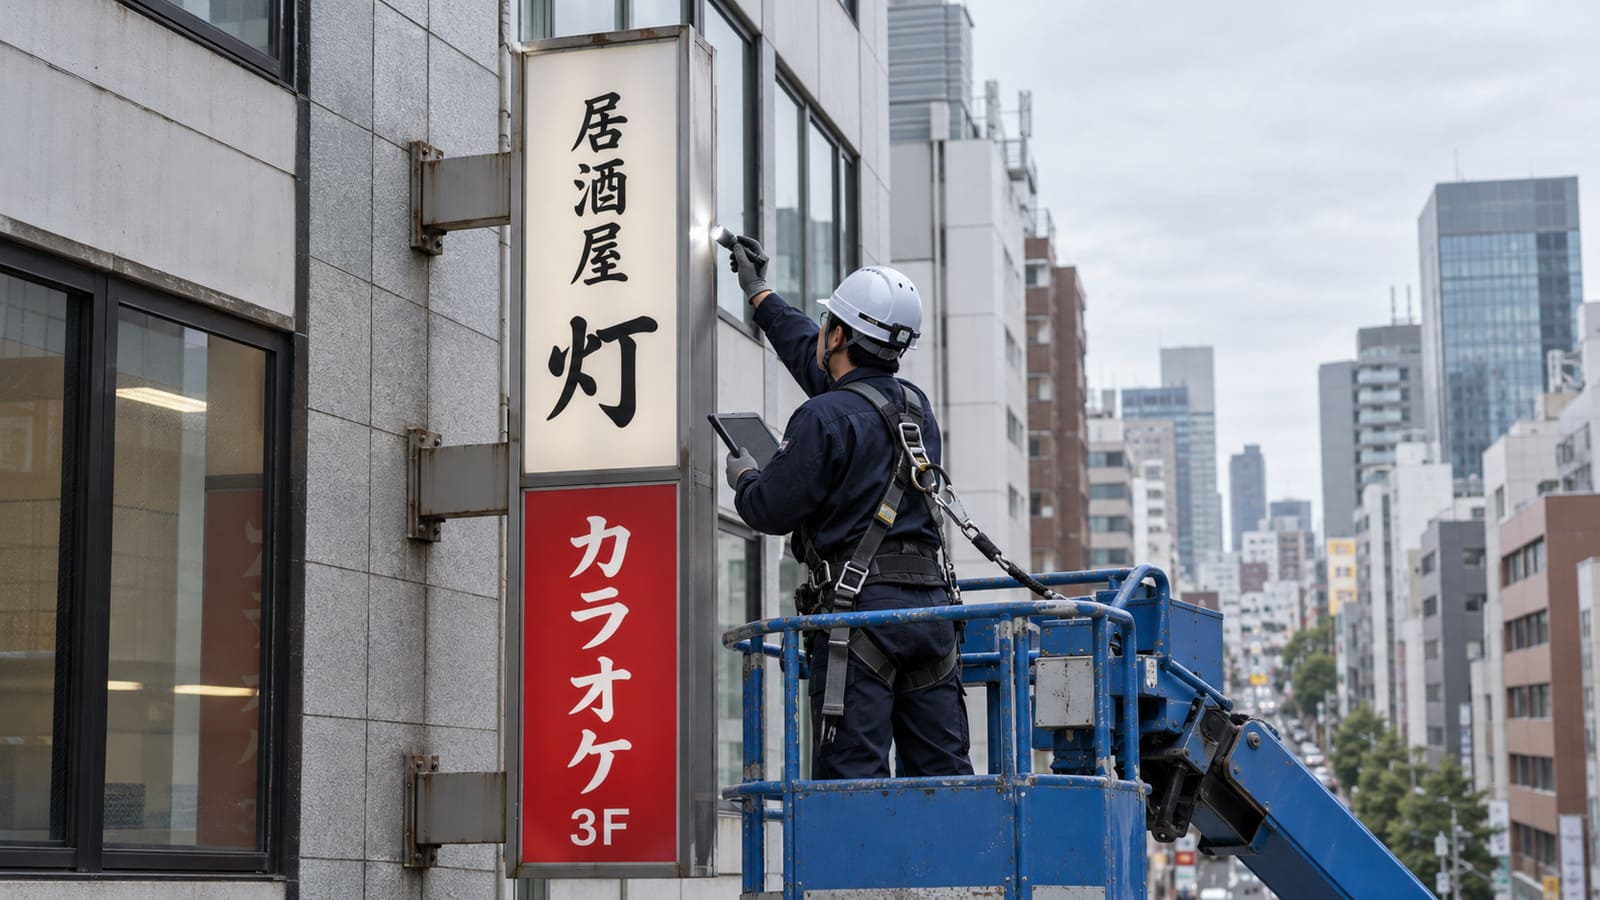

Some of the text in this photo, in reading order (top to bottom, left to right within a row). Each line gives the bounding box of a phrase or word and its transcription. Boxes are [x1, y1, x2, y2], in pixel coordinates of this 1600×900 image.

[547, 91, 659, 429] 居酒屋 灯
[568, 515, 633, 795] カラオケ
[570, 808, 630, 847] 3F
